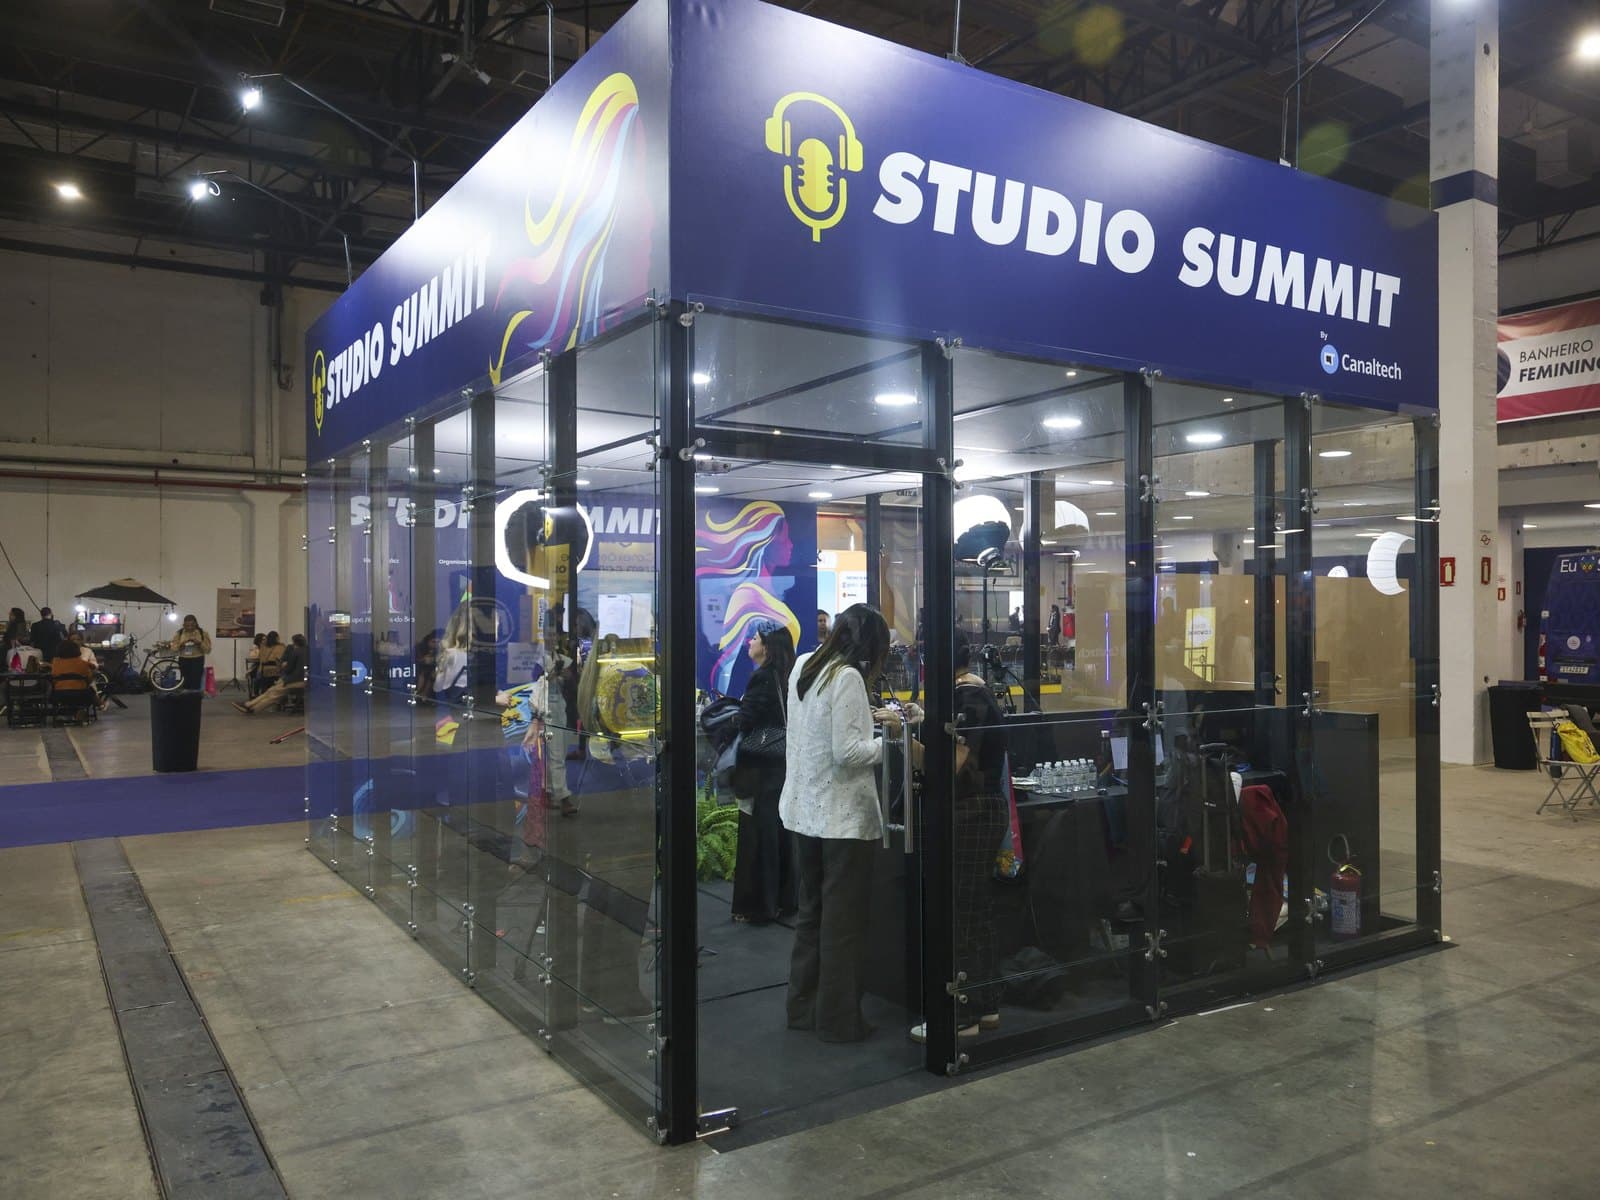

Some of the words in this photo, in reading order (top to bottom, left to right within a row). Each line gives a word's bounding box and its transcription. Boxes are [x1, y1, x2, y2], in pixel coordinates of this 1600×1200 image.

[872, 151, 1155, 273] STUDIO
[1178, 227, 1401, 328] SUMMIT
[326, 322, 384, 410] STUDIO
[390, 234, 490, 366] SUMMIT
[1320, 331, 1329, 341] By
[1519, 339, 1594, 363] BANHEIRO
[1341, 354, 1402, 380] Canaltech
[1519, 356, 1600, 382] FEMININ
[1560, 559, 1577, 572] Eu
